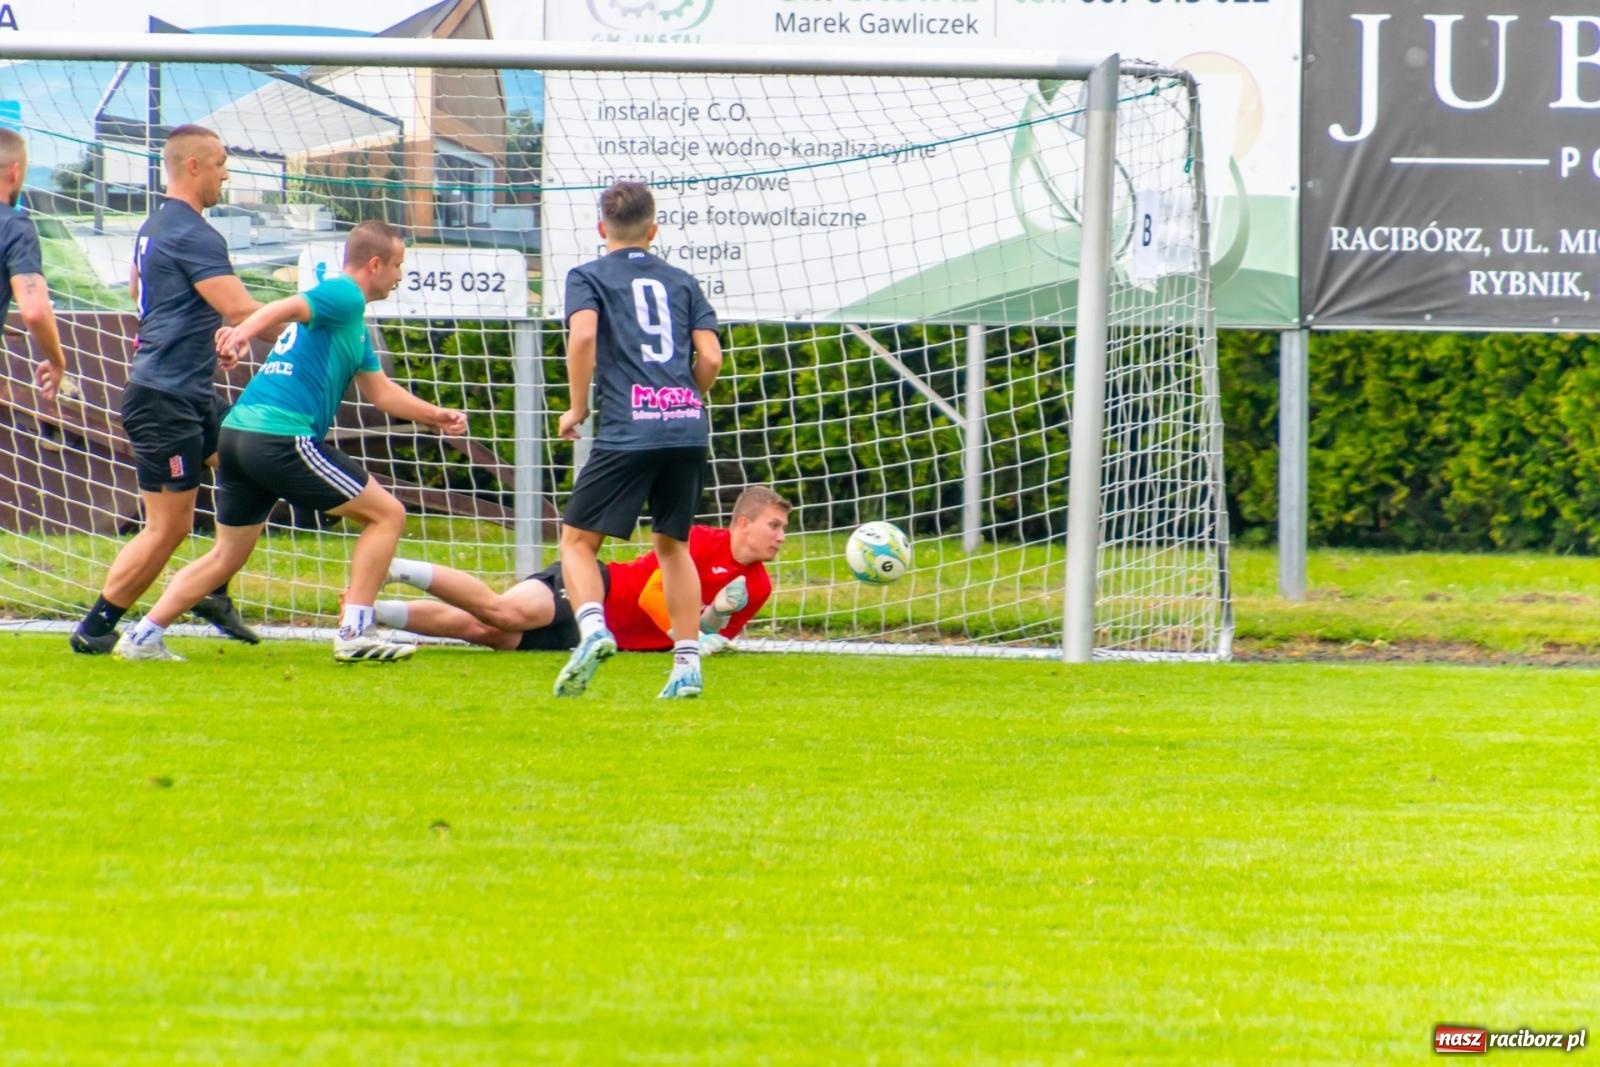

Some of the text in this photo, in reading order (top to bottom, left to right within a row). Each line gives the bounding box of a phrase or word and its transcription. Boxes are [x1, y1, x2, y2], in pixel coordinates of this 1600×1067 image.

[775, 12, 979, 35] Marek Gawliczek
[1328, 13, 1600, 142] JUB
[597, 101, 751, 124] instalacje C.O.
[597, 137, 937, 164] instalacje wodno-kanalizacyjne
[706, 175, 790, 196] gazowe
[706, 205, 867, 228] fotowoltaiczne
[1143, 213, 1152, 247] B
[1330, 220, 1600, 256] RACIBÓRZ, UL. MI
[679, 241, 742, 264] ciepła
[407, 271, 453, 292] 345
[460, 272, 506, 292] 032
[1469, 270, 1591, 301] RYBNIK,
[632, 278, 674, 363] 9
